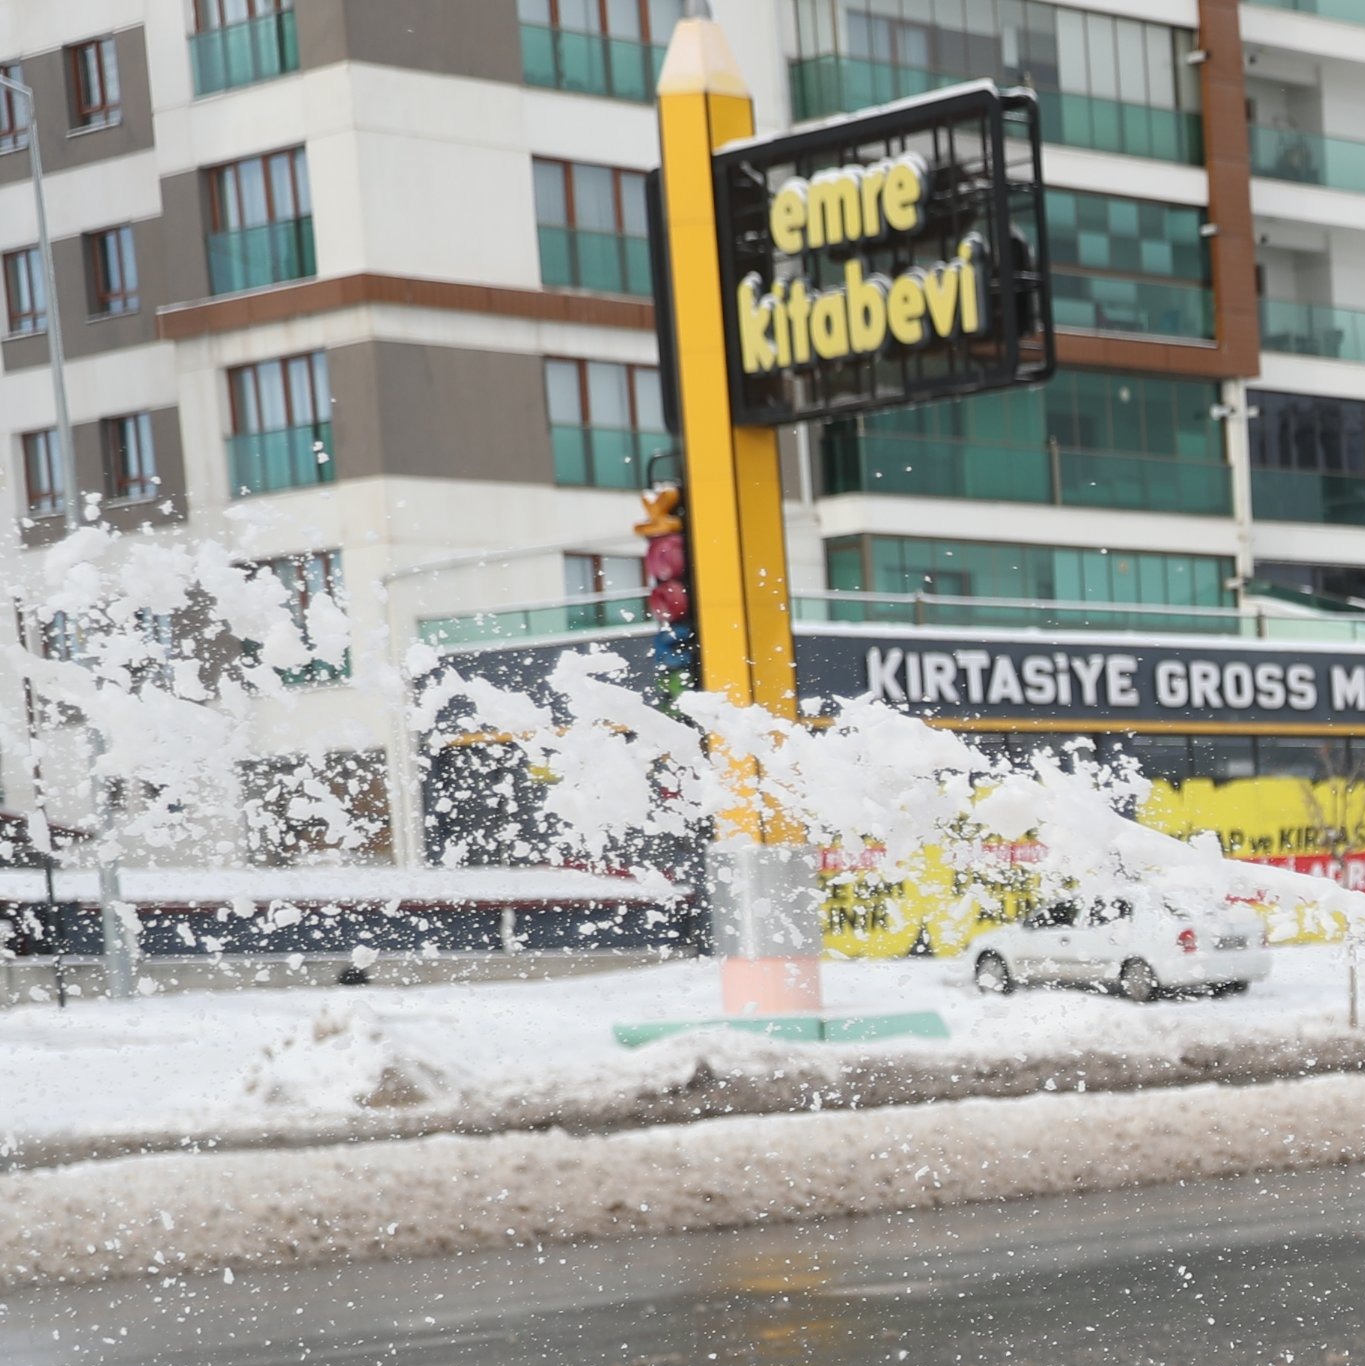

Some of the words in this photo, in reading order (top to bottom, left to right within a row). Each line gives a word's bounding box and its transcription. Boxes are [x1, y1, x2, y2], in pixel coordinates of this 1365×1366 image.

[770, 155, 925, 255] emre
[737, 234, 983, 374] kitabevi
[1155, 660, 1318, 709] GROSS
